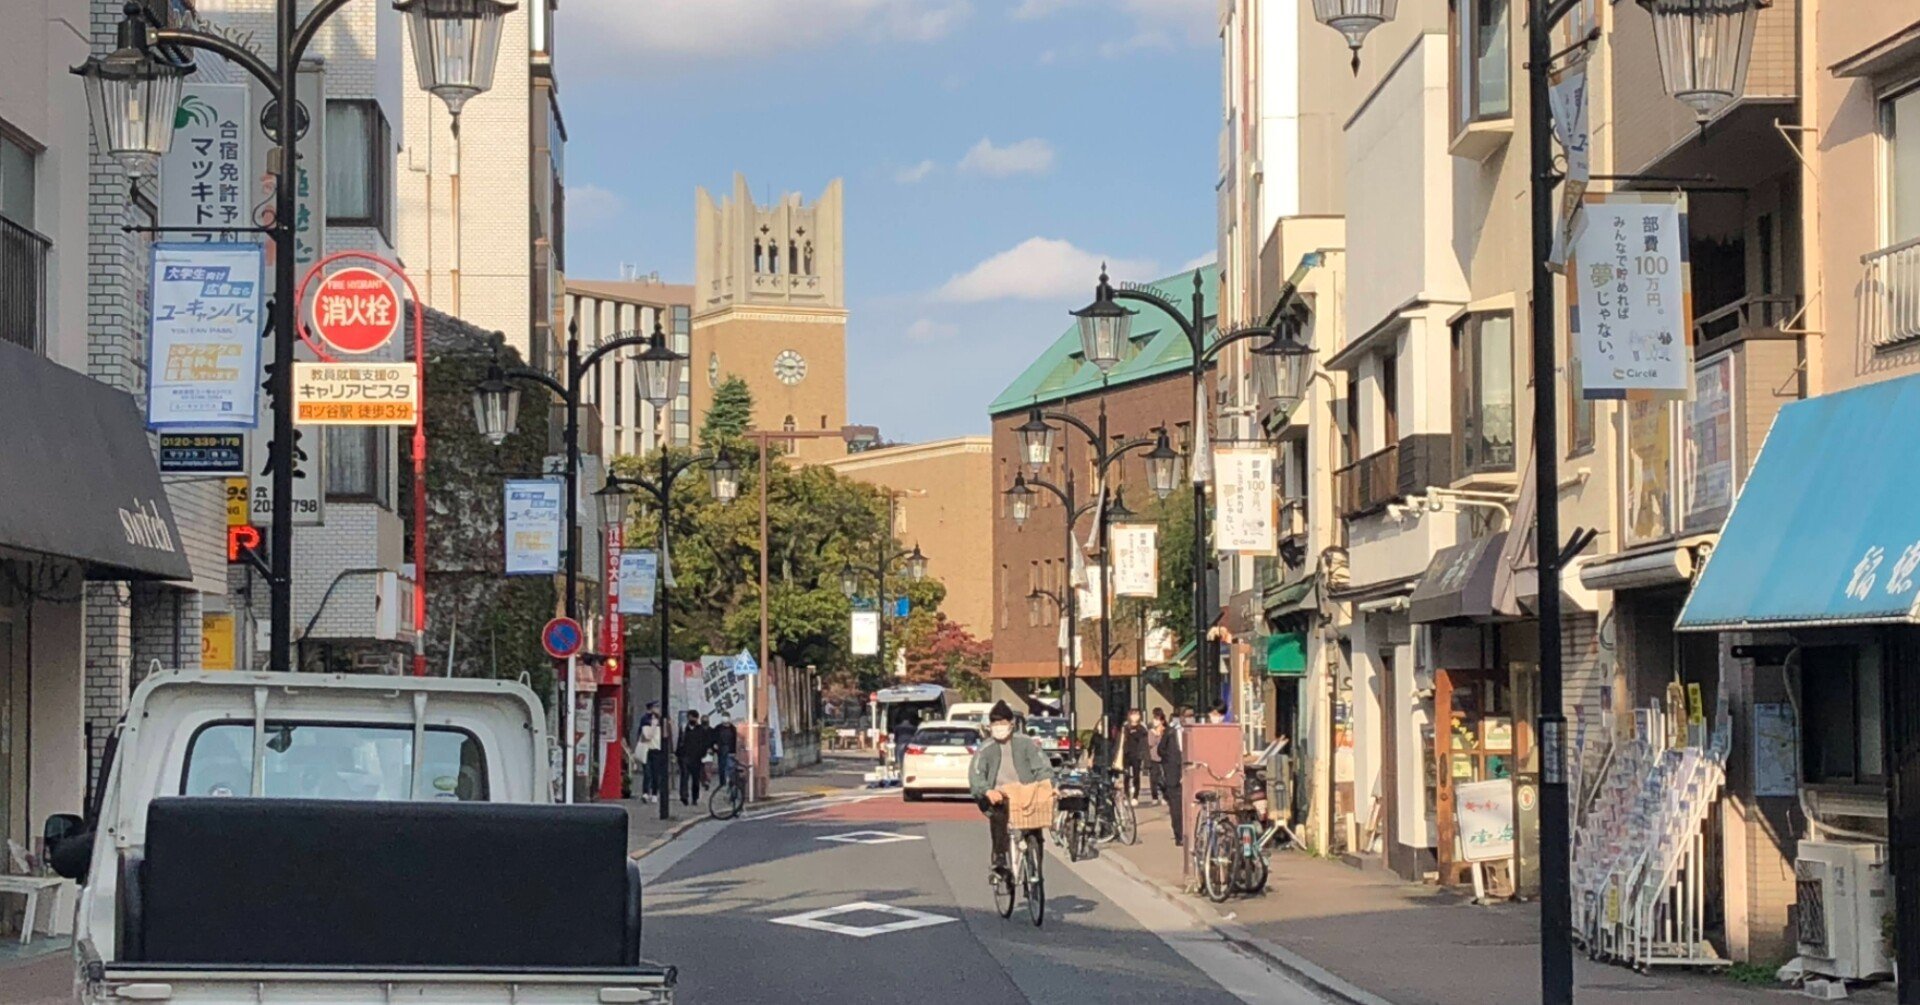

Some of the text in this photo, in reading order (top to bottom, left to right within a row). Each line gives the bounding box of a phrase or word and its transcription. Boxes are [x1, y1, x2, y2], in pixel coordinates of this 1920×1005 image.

[166, 267, 226, 281] 大学生向け
[1613, 216, 1629, 320] みんなで貯めれば
[328, 280, 345, 290] FIRE
[322, 294, 392, 327] 消火栓
[1590, 262, 1614, 361] 夢じゃない。
[311, 369, 400, 381] 教員就職支援の
[300, 384, 410, 399] キャリアビスタ
[300, 404, 410, 419] 四ツ谷駅 徒歩3分
[119, 497, 175, 552] switch
[229, 526, 260, 561] P
